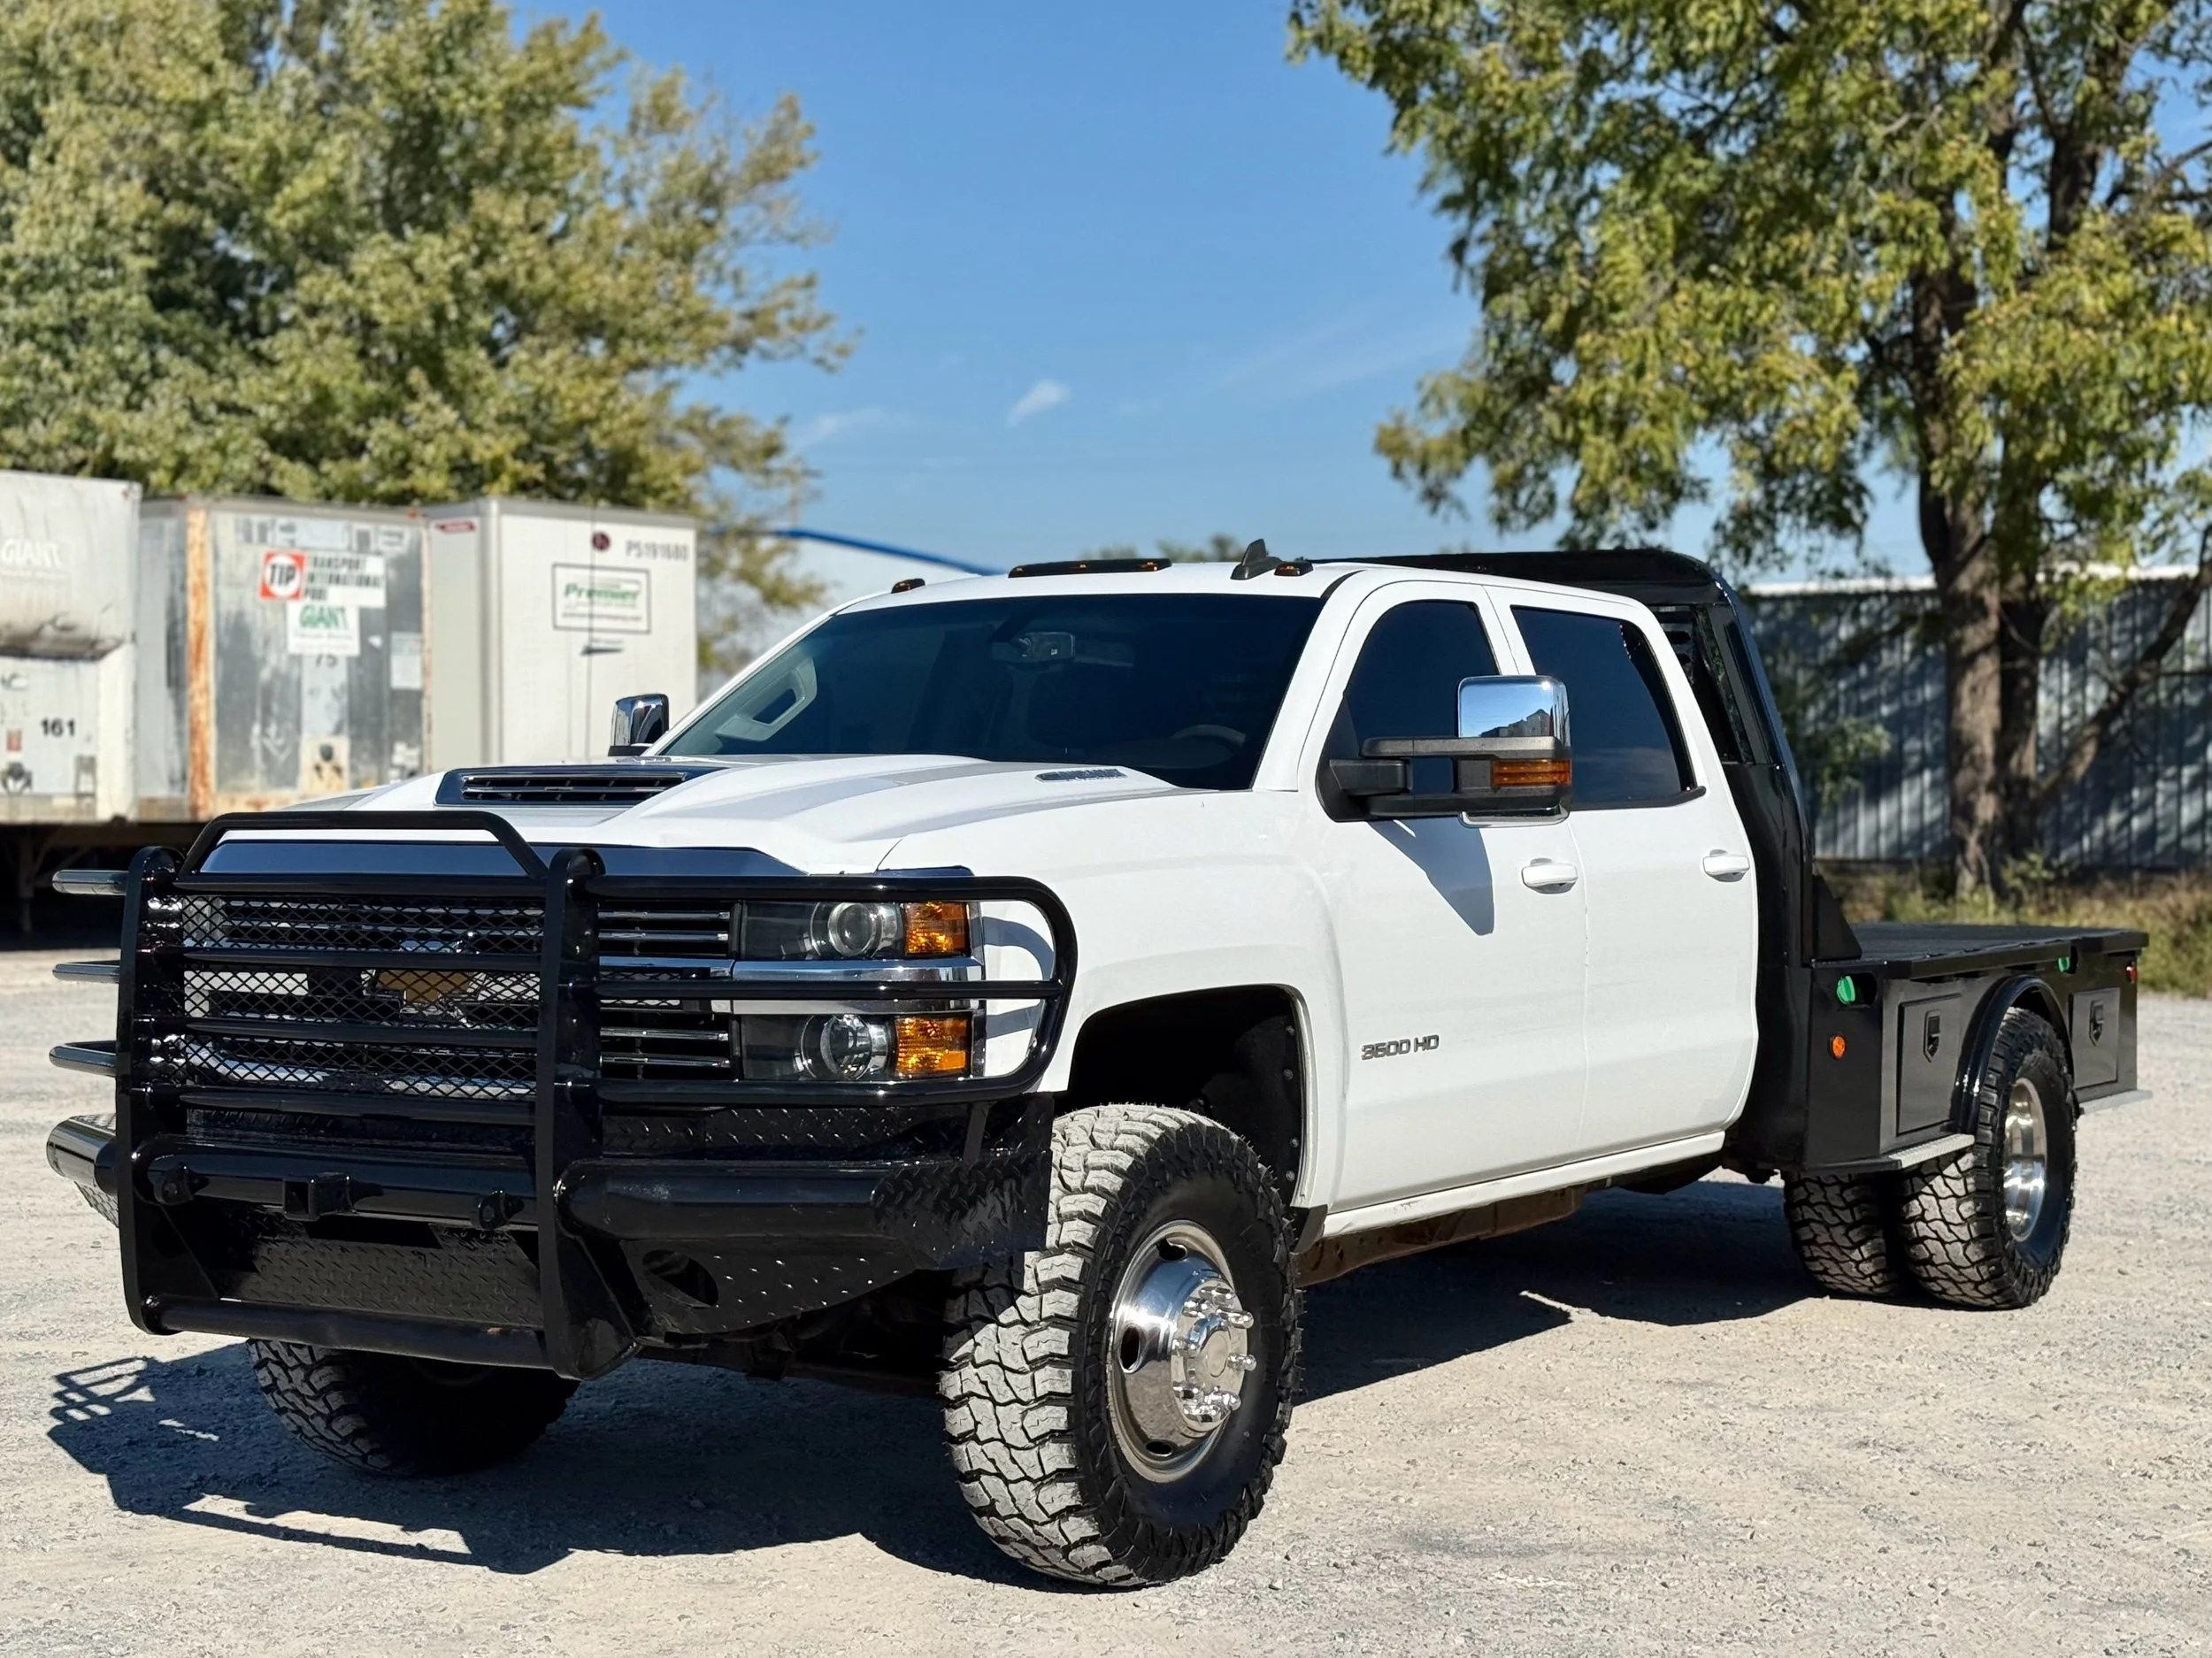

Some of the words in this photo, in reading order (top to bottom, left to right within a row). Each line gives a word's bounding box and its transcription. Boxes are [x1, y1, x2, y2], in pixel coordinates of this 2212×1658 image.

[269, 564, 297, 585] TIP
[300, 604, 348, 629] GIANT
[41, 718, 75, 737] 161
[1414, 1034, 1440, 1053] HD
